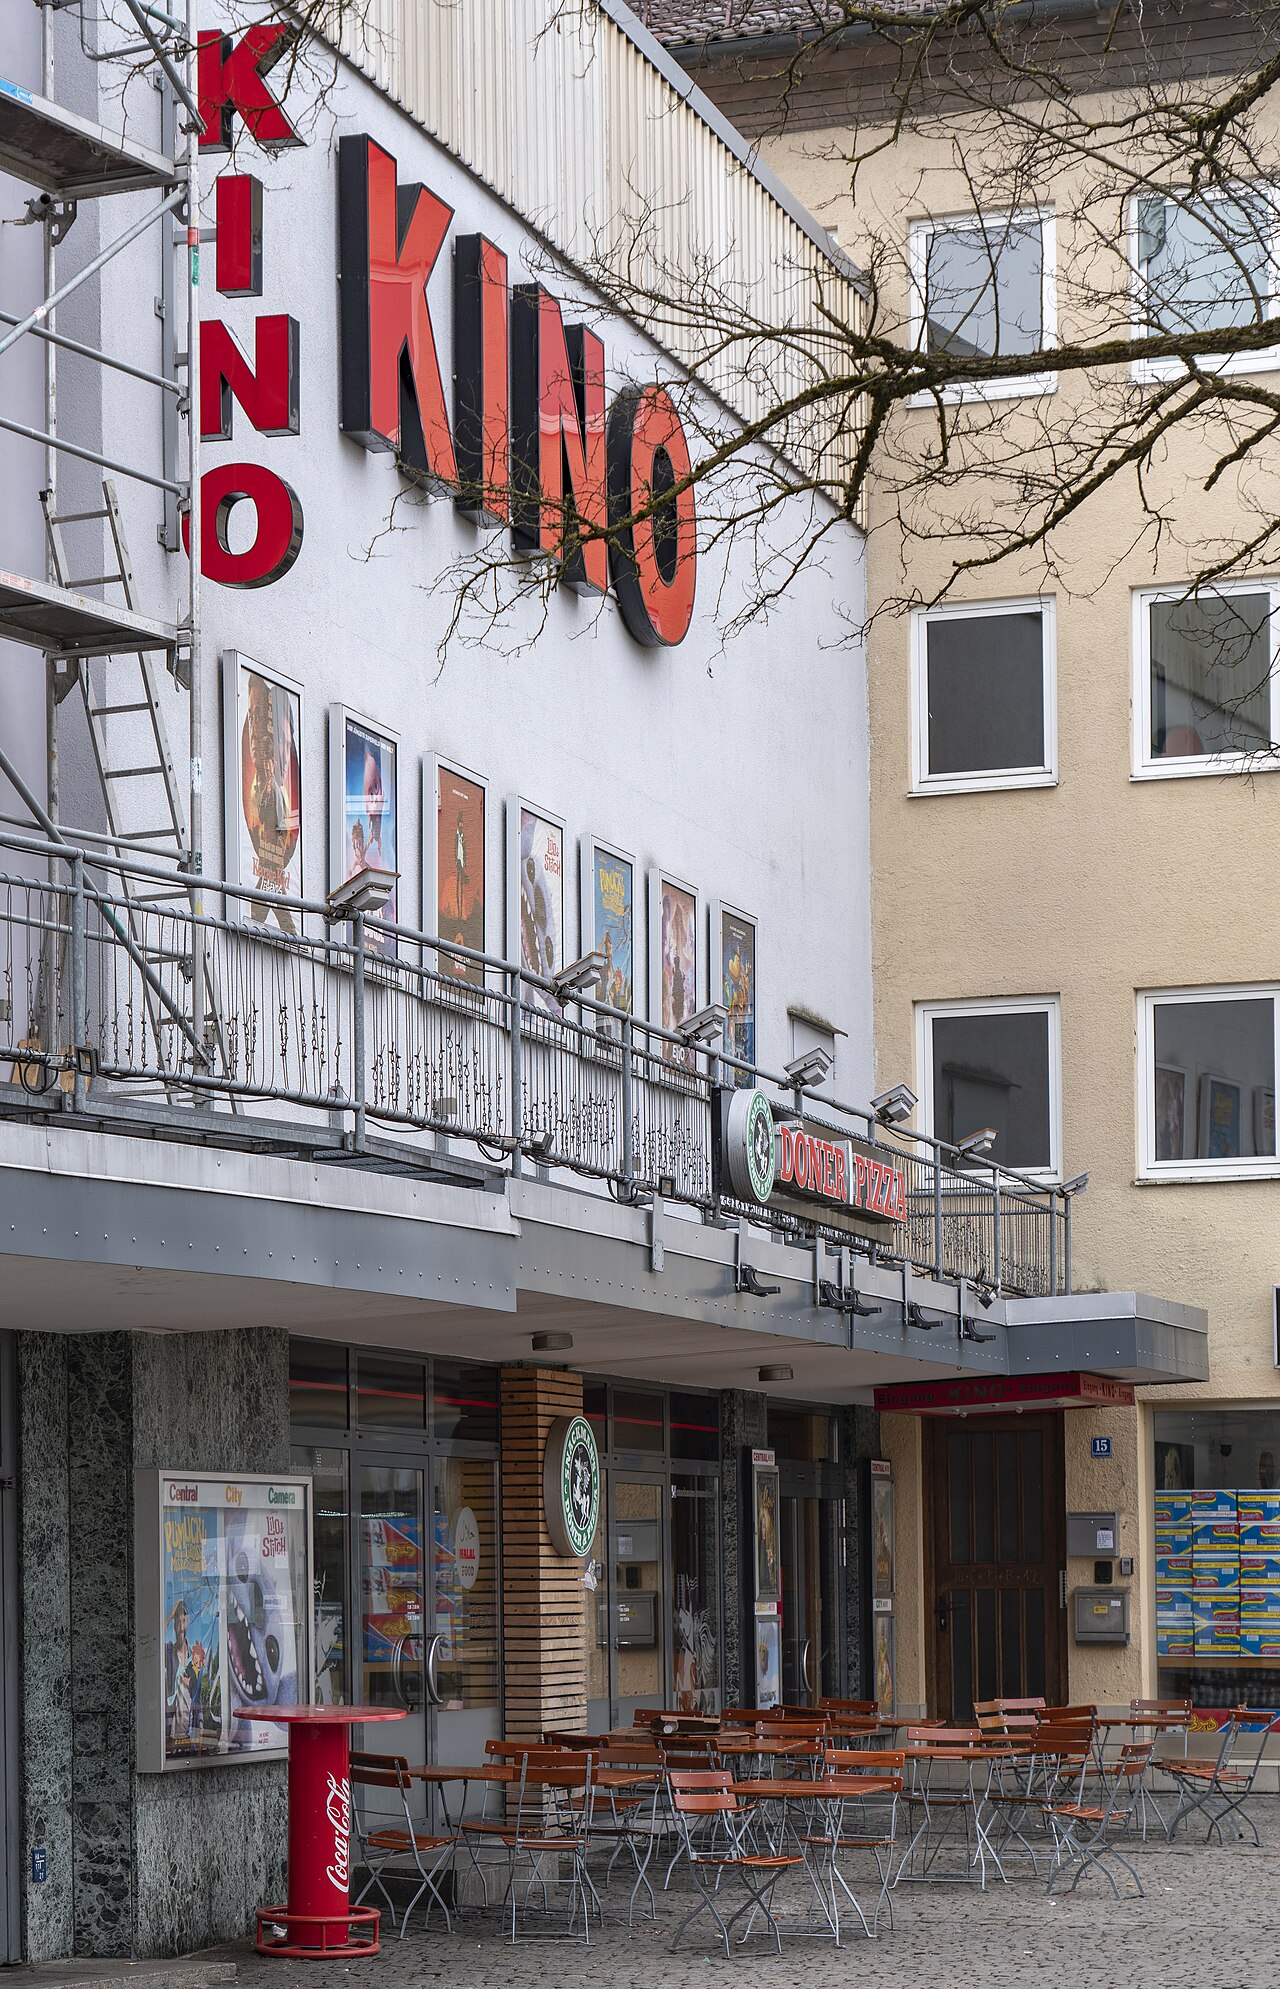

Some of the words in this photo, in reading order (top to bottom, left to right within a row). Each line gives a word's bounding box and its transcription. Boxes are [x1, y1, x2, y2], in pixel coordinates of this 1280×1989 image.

[184, 22, 304, 589] KINO
[340, 132, 697, 647] KINO
[855, 1153, 907, 1223] PIZZA
[877, 1391, 935, 1408] Eingang
[1019, 1380, 1078, 1395] Eingang
[753, 1451, 768, 1463] CENTRAL
[1095, 1439, 1108, 1452] 15
[169, 1482, 198, 1502] Central
[225, 1484, 243, 1506] City
[268, 1486, 296, 1505] Camera
[459, 1548, 476, 1560] HALAL
[461, 1565, 475, 1577] FOOD
